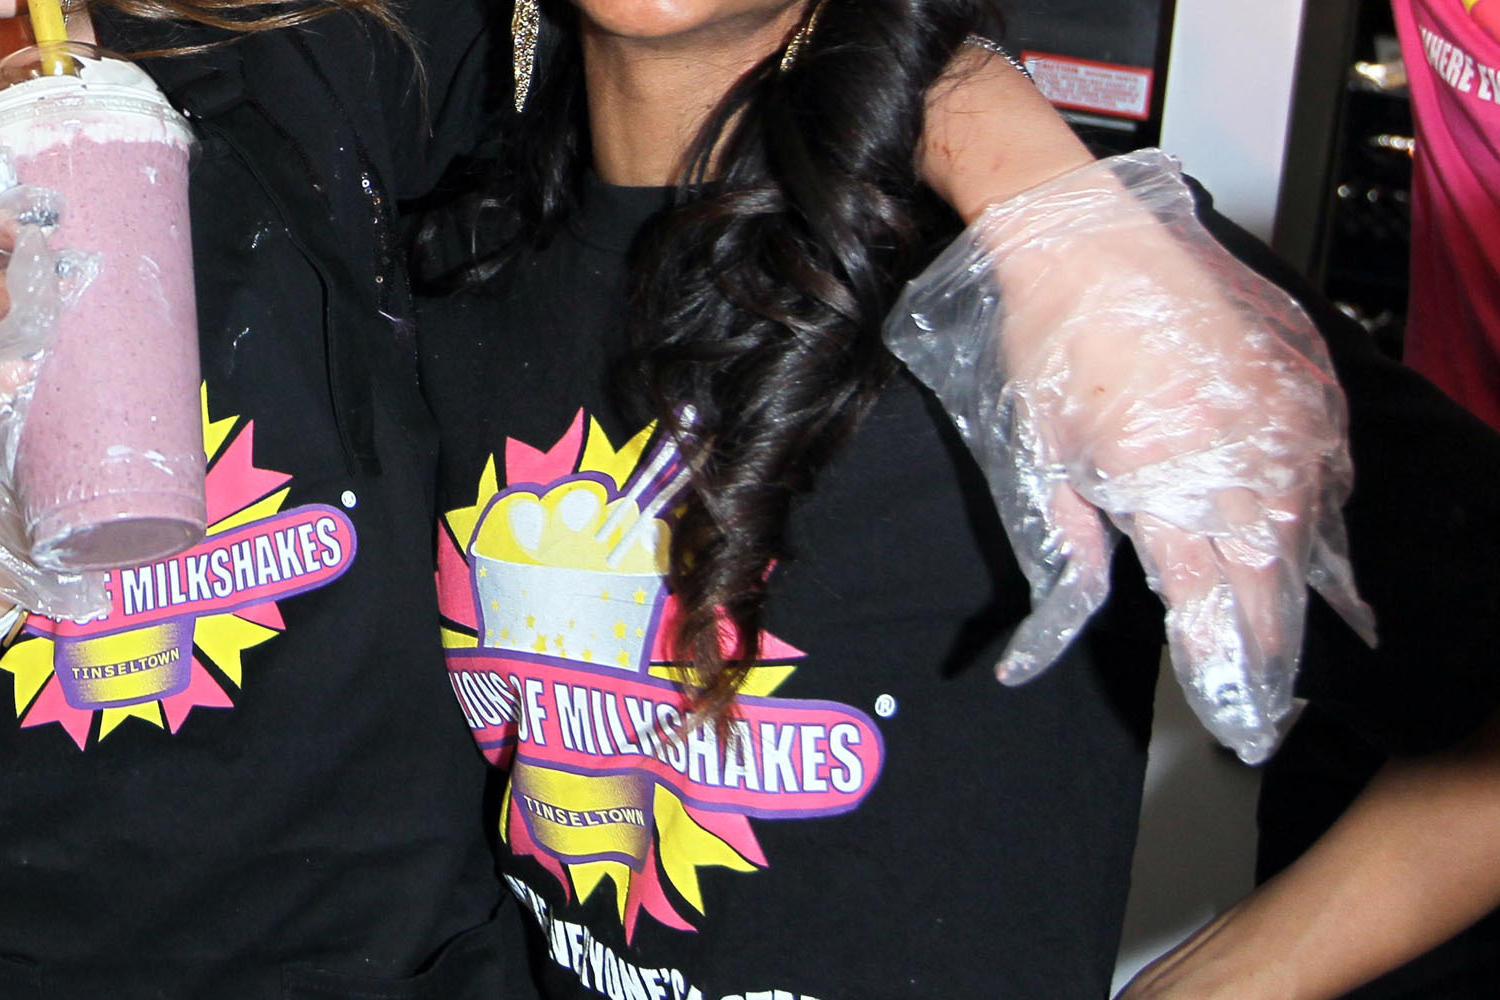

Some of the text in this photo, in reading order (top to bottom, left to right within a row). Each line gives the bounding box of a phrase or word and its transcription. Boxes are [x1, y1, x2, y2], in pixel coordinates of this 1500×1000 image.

[121, 517, 342, 616] MILKSHAKES
[71, 648, 180, 680] TINSELTOWN
[553, 681, 863, 794] MILKSHAKES
[523, 794, 645, 827] TINSELTOWN
